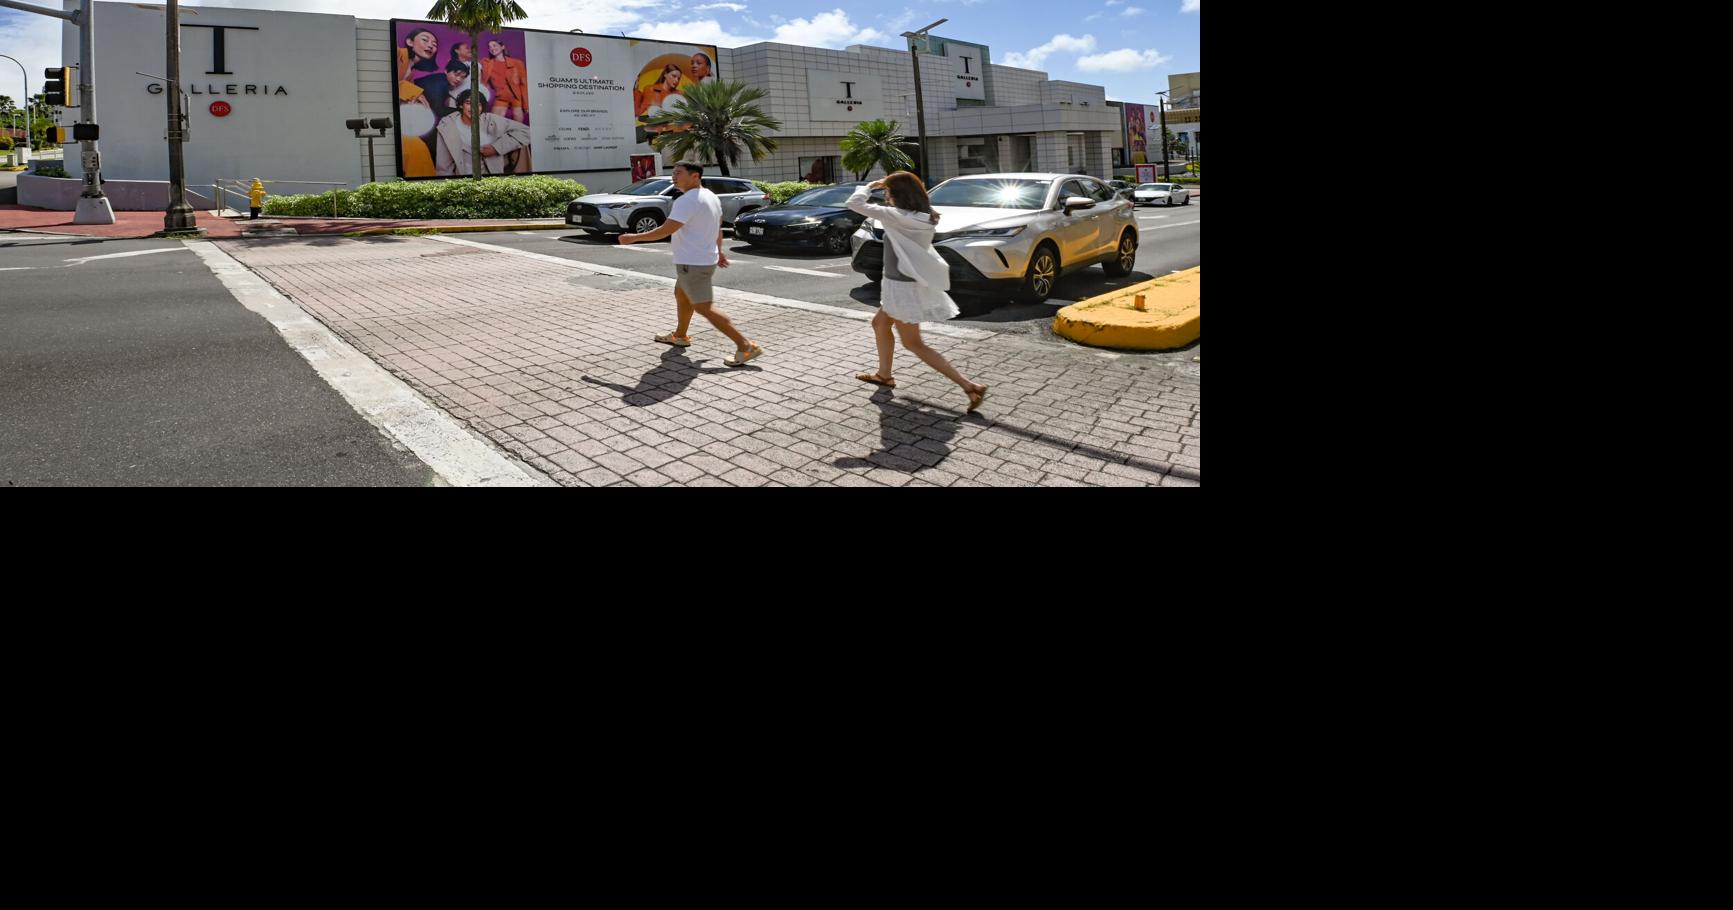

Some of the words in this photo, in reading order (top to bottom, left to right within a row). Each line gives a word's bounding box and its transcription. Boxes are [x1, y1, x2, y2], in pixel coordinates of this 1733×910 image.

[179, 24, 259, 74] T
[572, 53, 591, 62] DFS
[959, 56, 973, 74] T
[147, 83, 288, 95] GLLERIA
[839, 81, 856, 98] T
[212, 104, 230, 113] DFS
